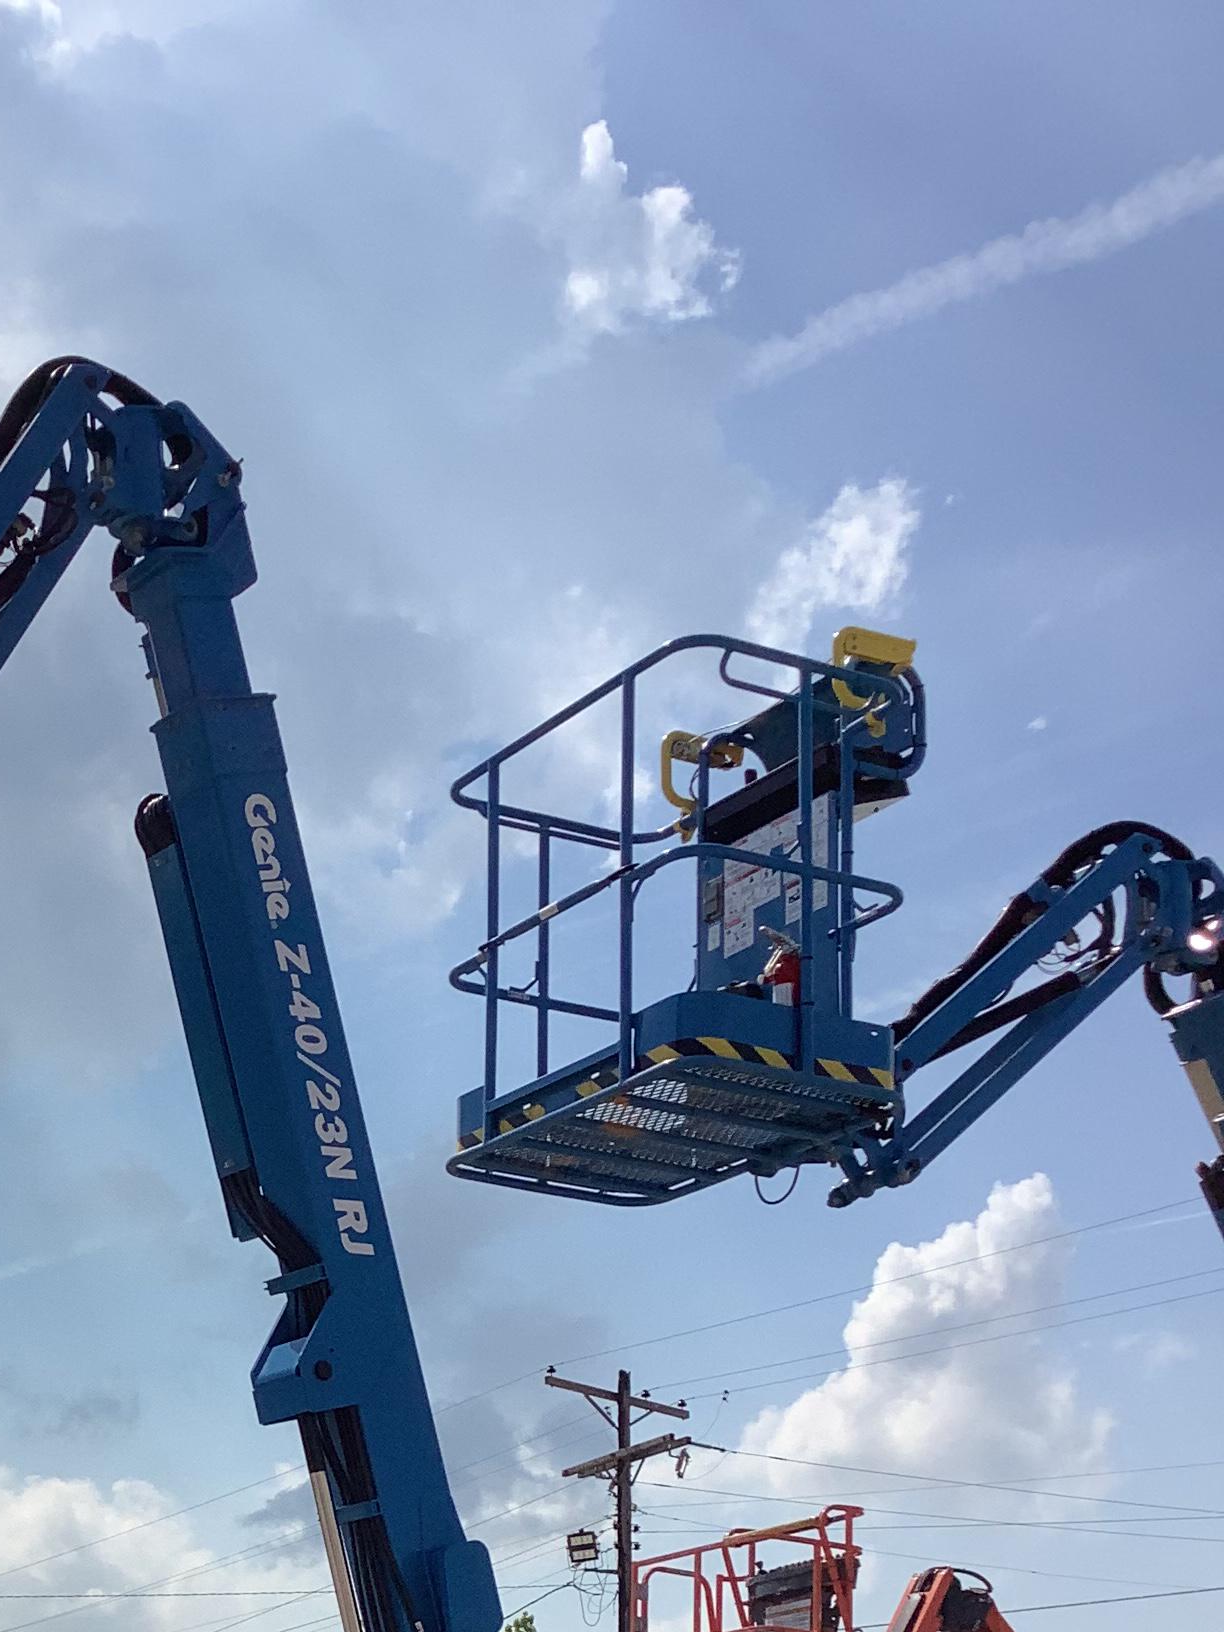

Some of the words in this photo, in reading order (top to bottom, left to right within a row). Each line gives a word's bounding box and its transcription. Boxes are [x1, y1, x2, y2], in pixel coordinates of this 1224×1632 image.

[244, 793, 290, 924] Genie
[275, 939, 359, 1181] Z-40/23N
[332, 1197, 375, 1258] RJ
